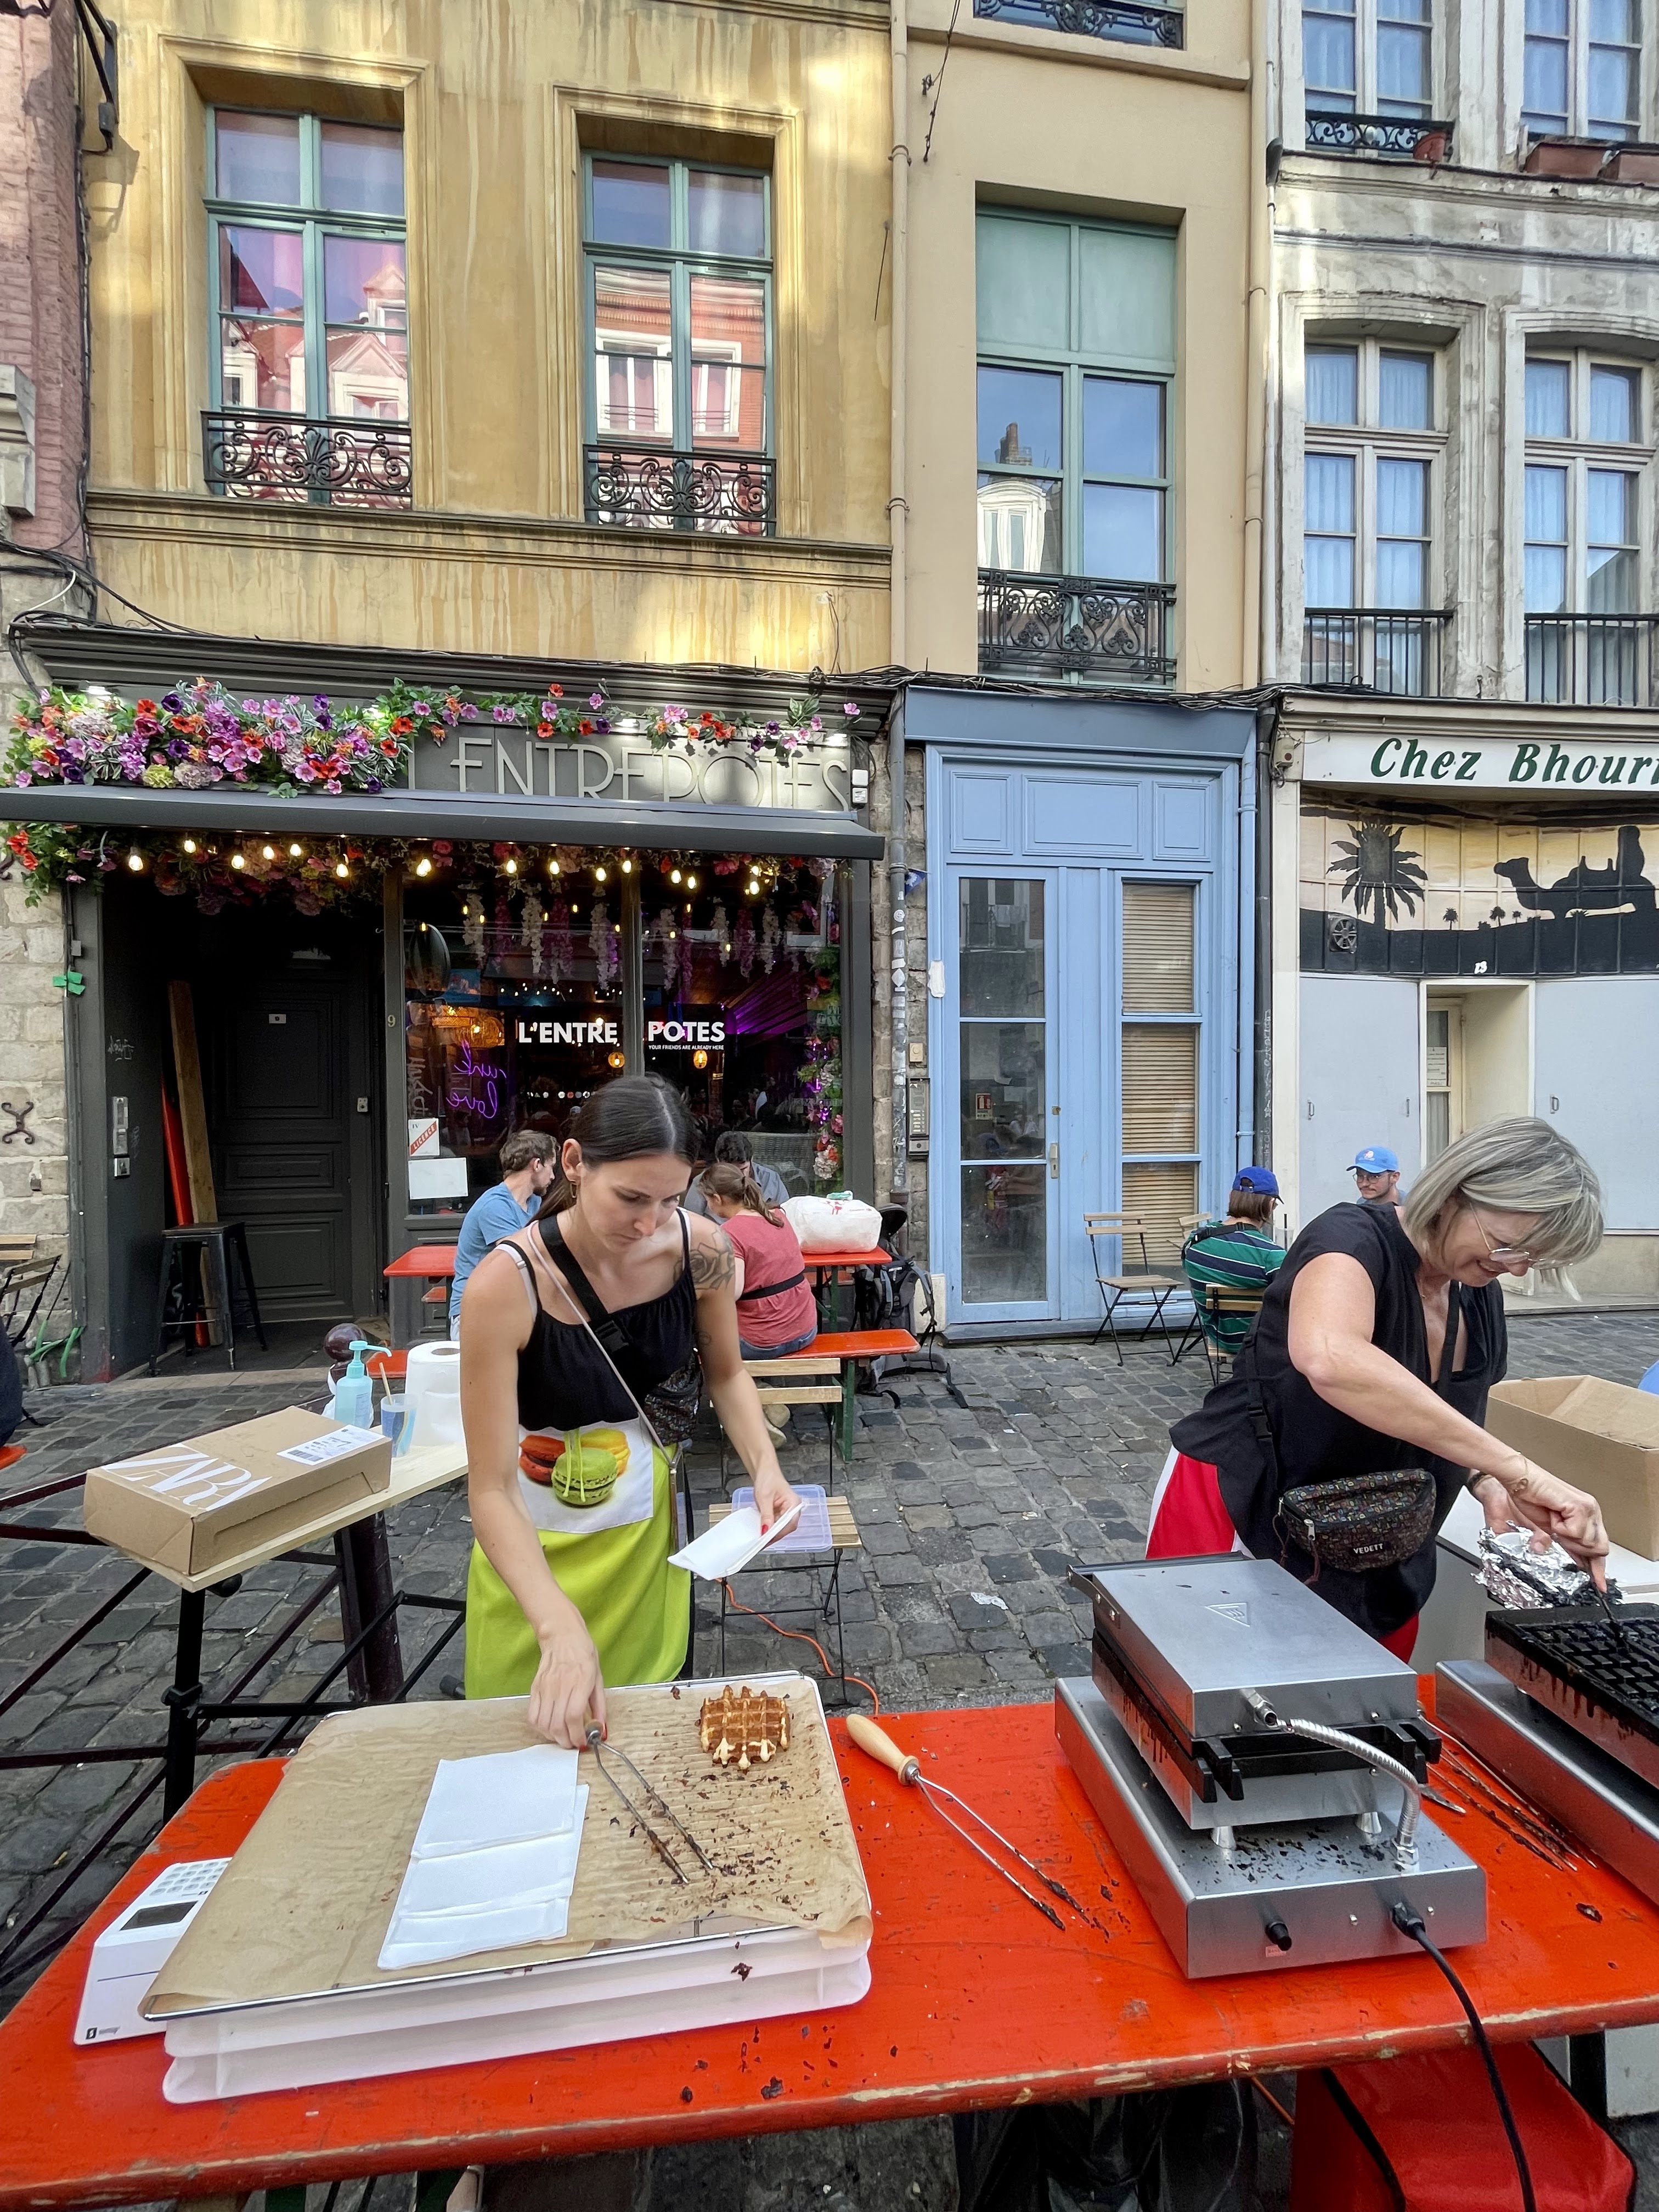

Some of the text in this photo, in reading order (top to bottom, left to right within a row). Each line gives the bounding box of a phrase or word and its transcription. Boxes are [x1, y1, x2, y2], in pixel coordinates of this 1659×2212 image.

[1371, 738, 1482, 781] Chez
[387, 1014, 396, 1028] 9
[518, 1020, 725, 1043] L'ENTRE POTES
[413, 1125, 435, 1150] LICENCE
[101, 1443, 273, 1511] ZARA
[1353, 1543, 1384, 1554] VEDETT
